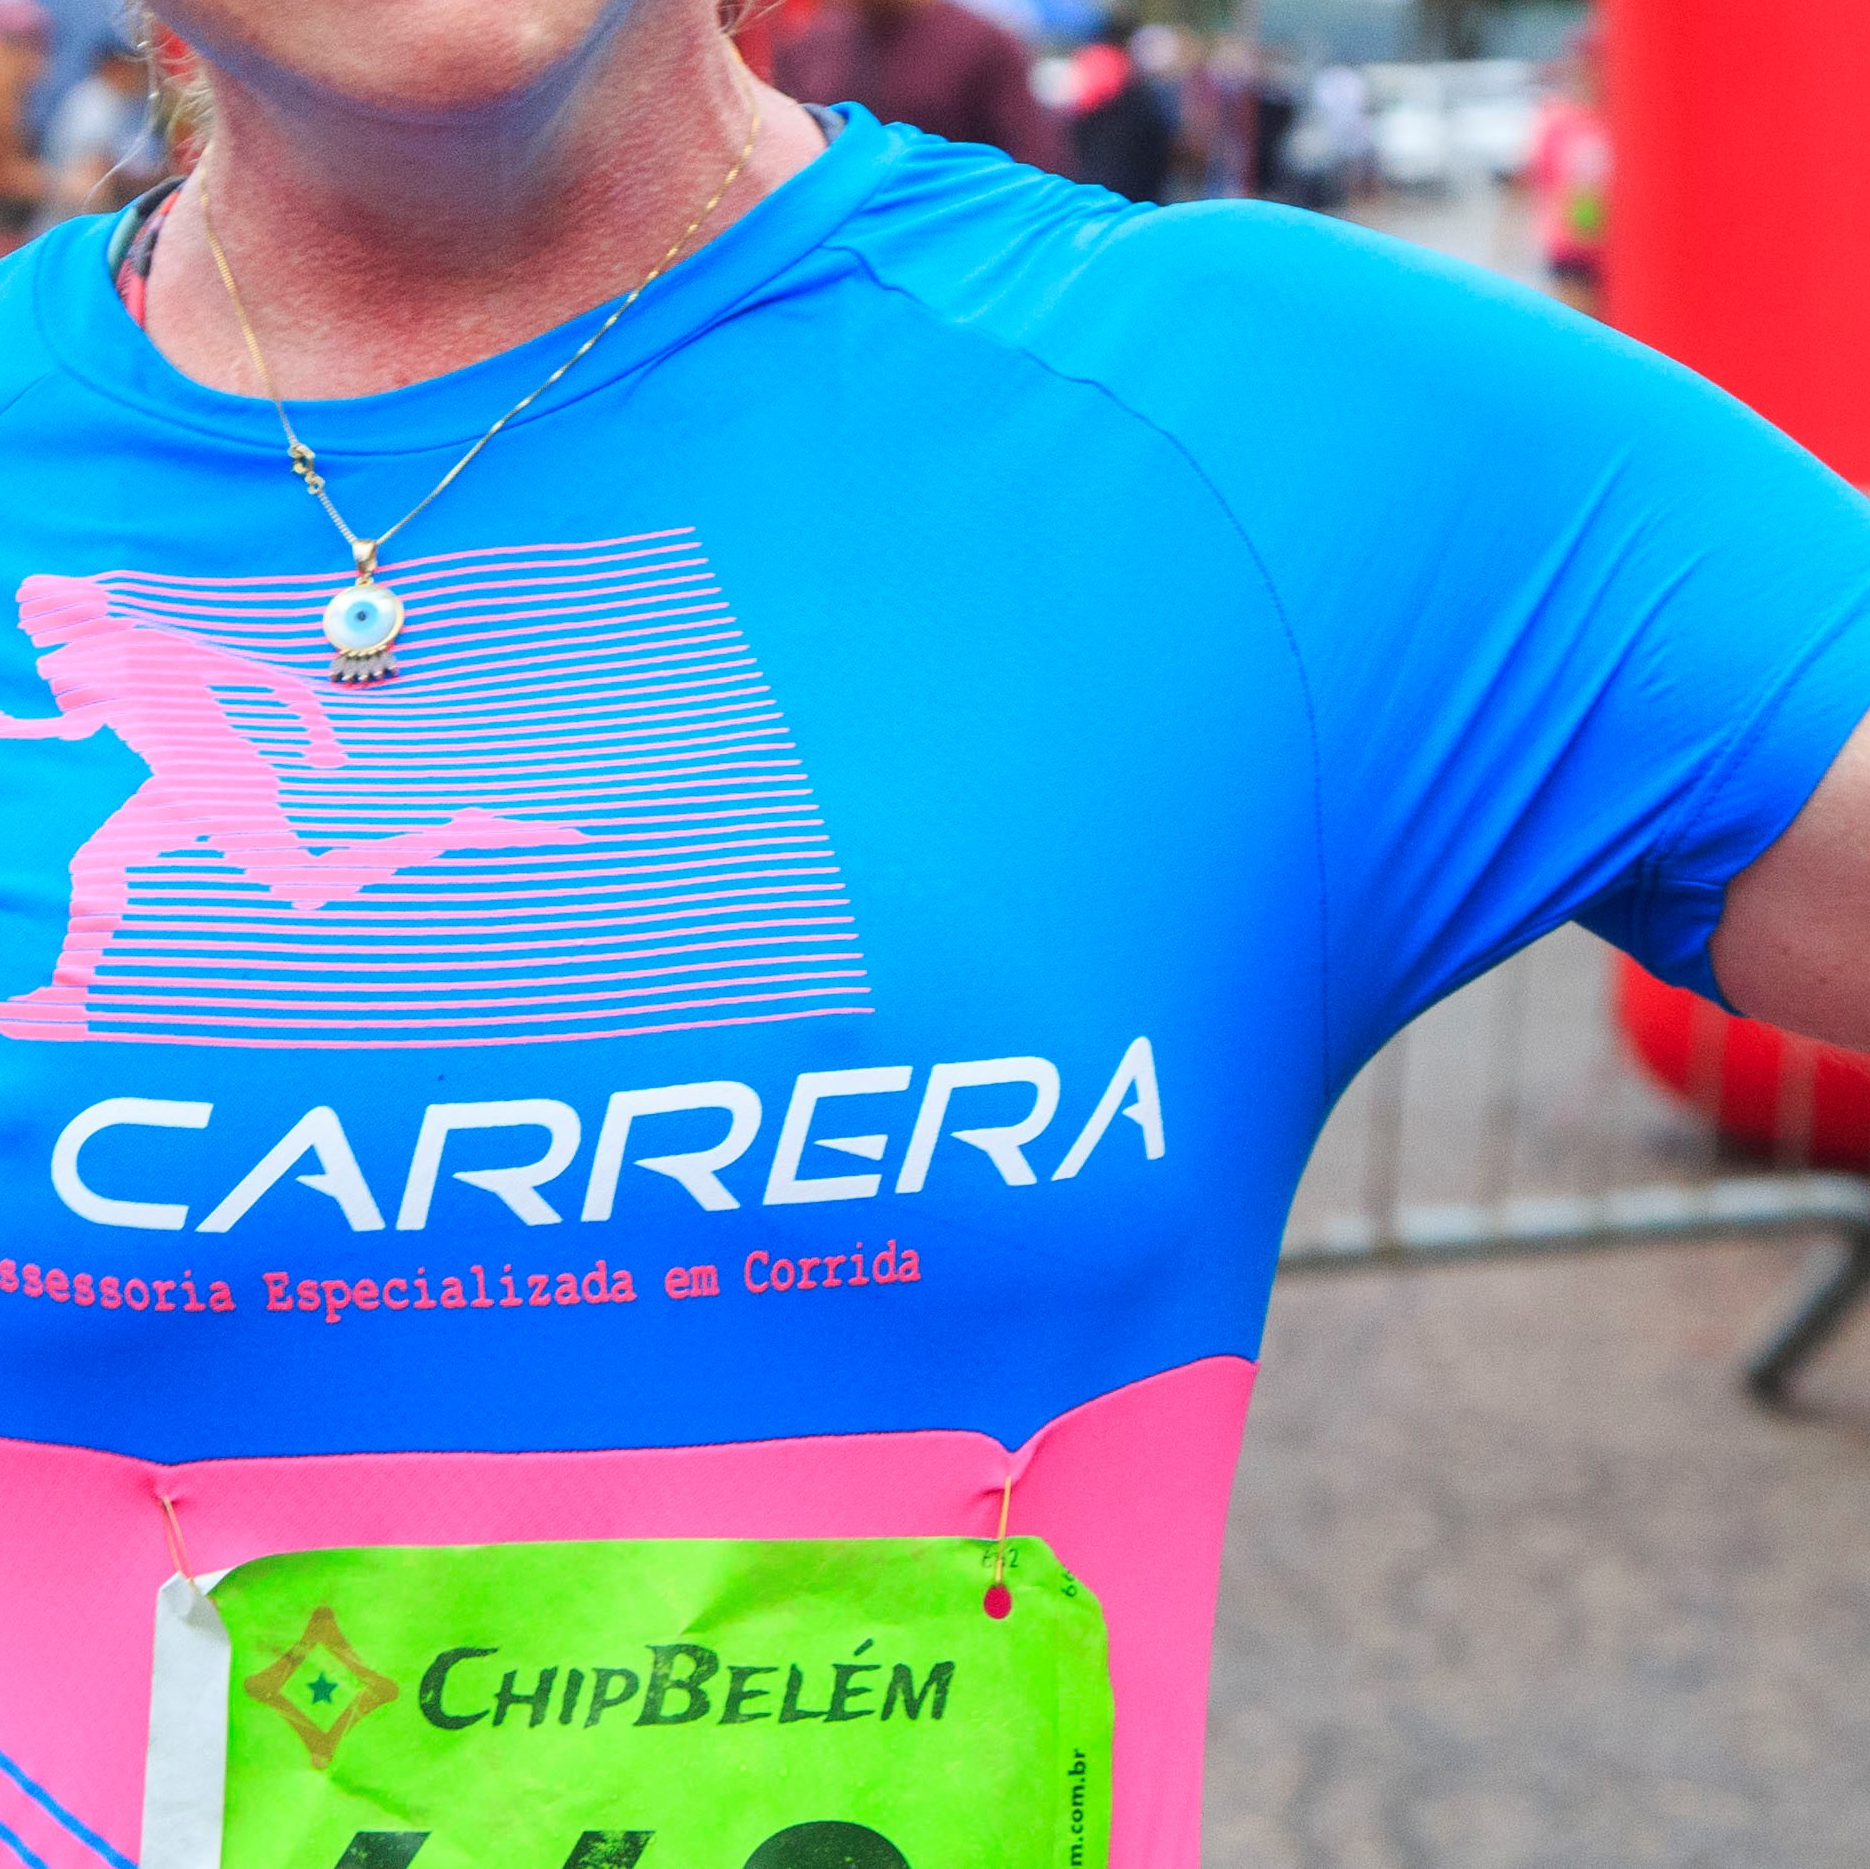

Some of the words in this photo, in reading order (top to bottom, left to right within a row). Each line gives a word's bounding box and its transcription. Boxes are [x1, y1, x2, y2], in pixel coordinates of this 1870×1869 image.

[49, 1035, 1166, 1234] CARRERA
[261, 1258, 638, 1325] Especializada
[665, 1263, 721, 1301] em
[742, 1238, 921, 1295] Corrida
[1068, 1746, 1086, 1869] m.com.br
